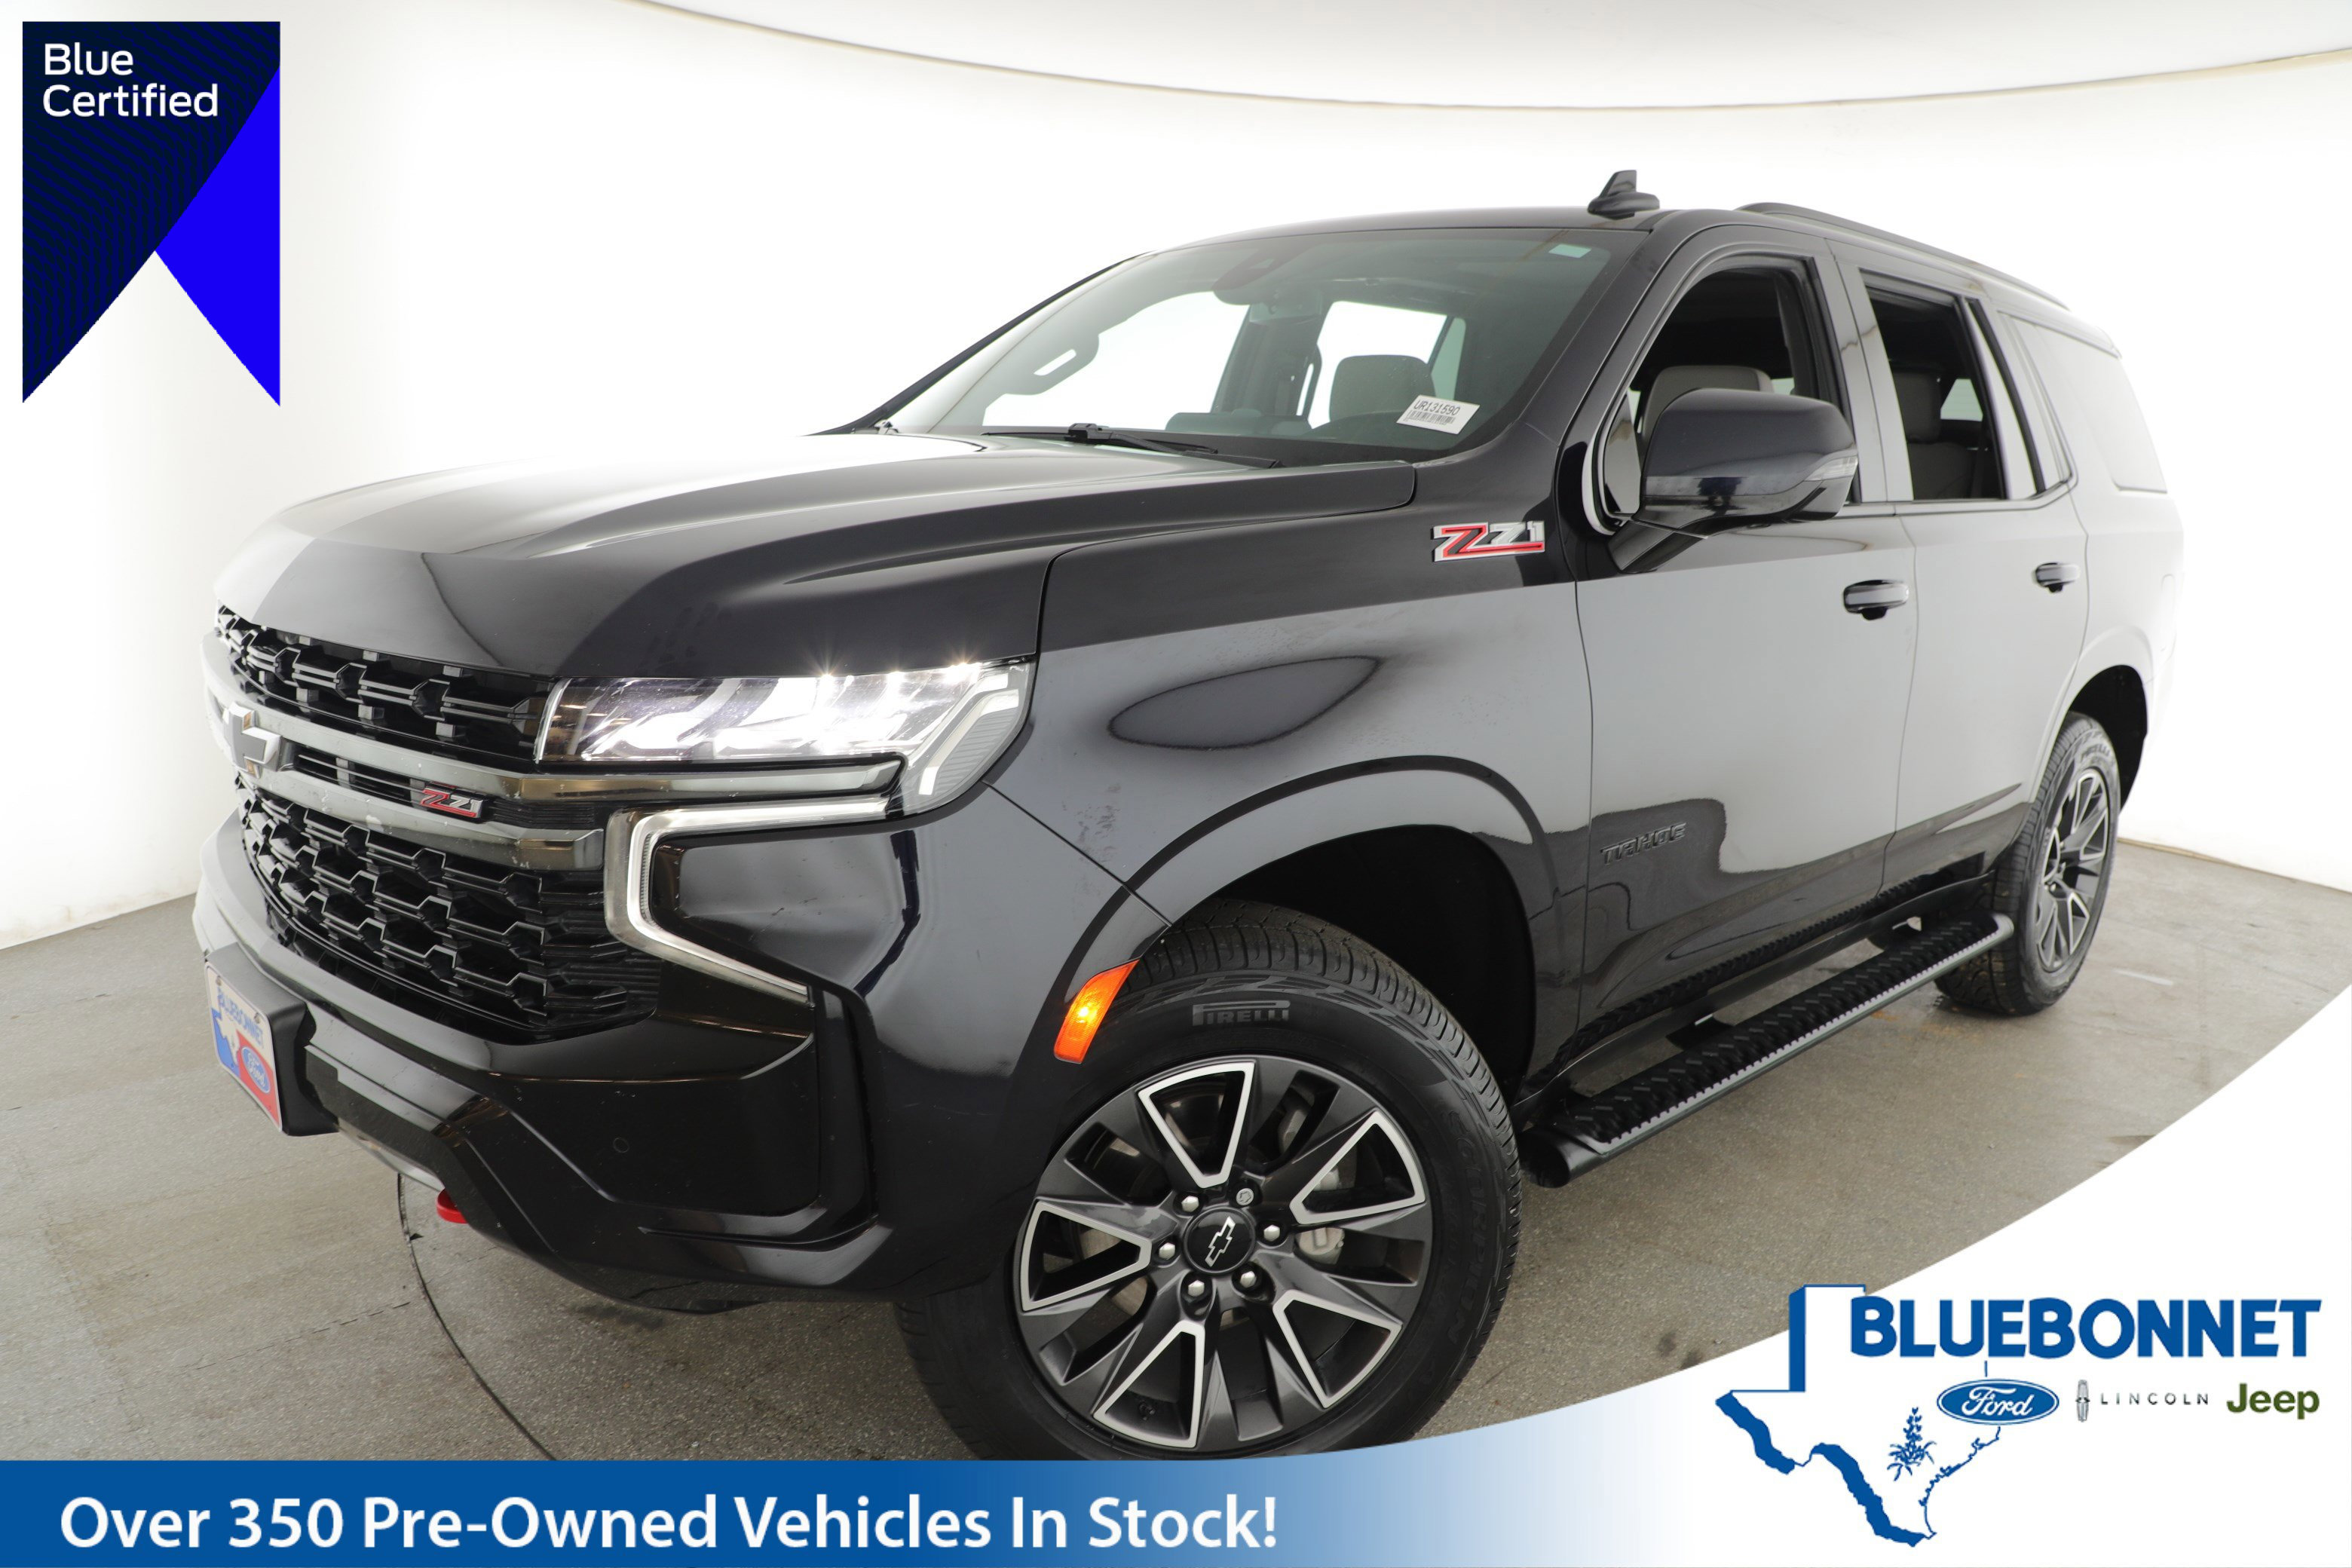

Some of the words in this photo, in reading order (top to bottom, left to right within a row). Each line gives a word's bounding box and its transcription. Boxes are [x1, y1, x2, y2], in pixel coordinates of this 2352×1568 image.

[1413, 400, 1461, 416] UR131590
[1432, 520, 1545, 562] Z71
[420, 787, 483, 818] Z71
[1600, 822, 1686, 865] TAHOE
[1192, 1000, 1291, 1026] PIRELLI
